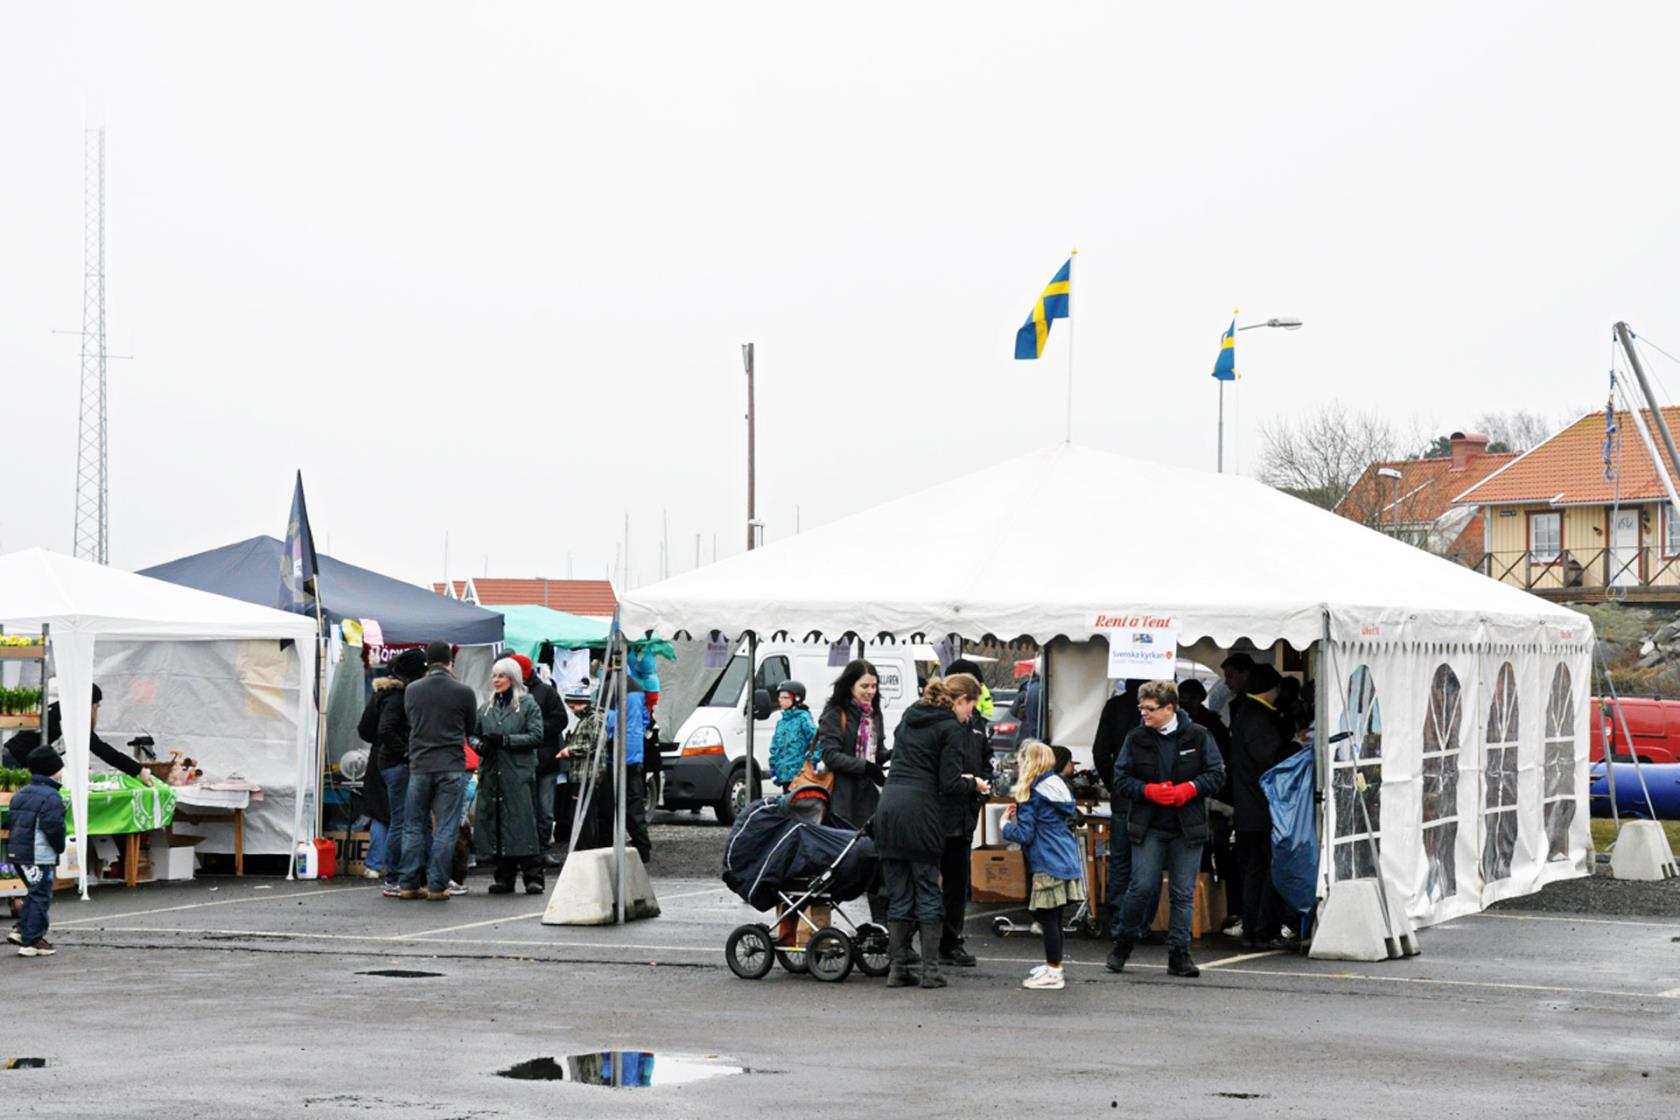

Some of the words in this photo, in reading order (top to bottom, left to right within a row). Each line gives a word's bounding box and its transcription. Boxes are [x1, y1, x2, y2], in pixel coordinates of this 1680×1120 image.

[1095, 615, 1128, 628] Rent
[1129, 617, 1140, 628] a
[1142, 615, 1171, 629] Tent
[1112, 650, 1140, 658] Svenska
[1140, 650, 1164, 660] kyrkan
